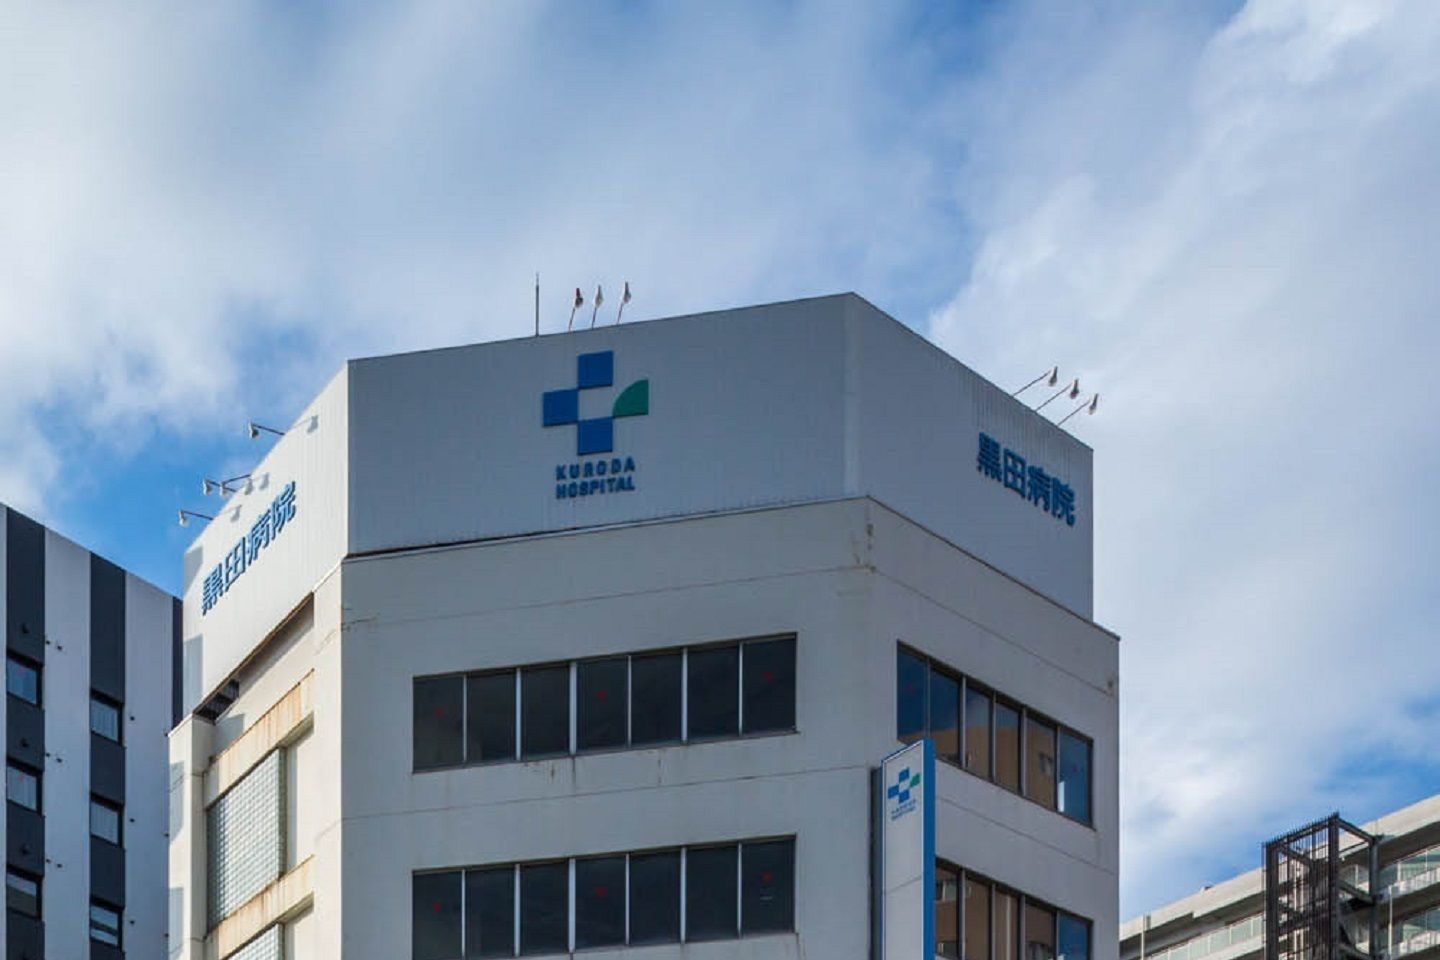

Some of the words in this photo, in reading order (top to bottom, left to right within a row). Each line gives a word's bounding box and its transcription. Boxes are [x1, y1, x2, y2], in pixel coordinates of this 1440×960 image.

[556, 457, 635, 481] KURODA
[556, 476, 635, 499] HOSPITAL
[977, 432, 1075, 527] 黒田病院
[203, 481, 296, 616] 黒田病院
